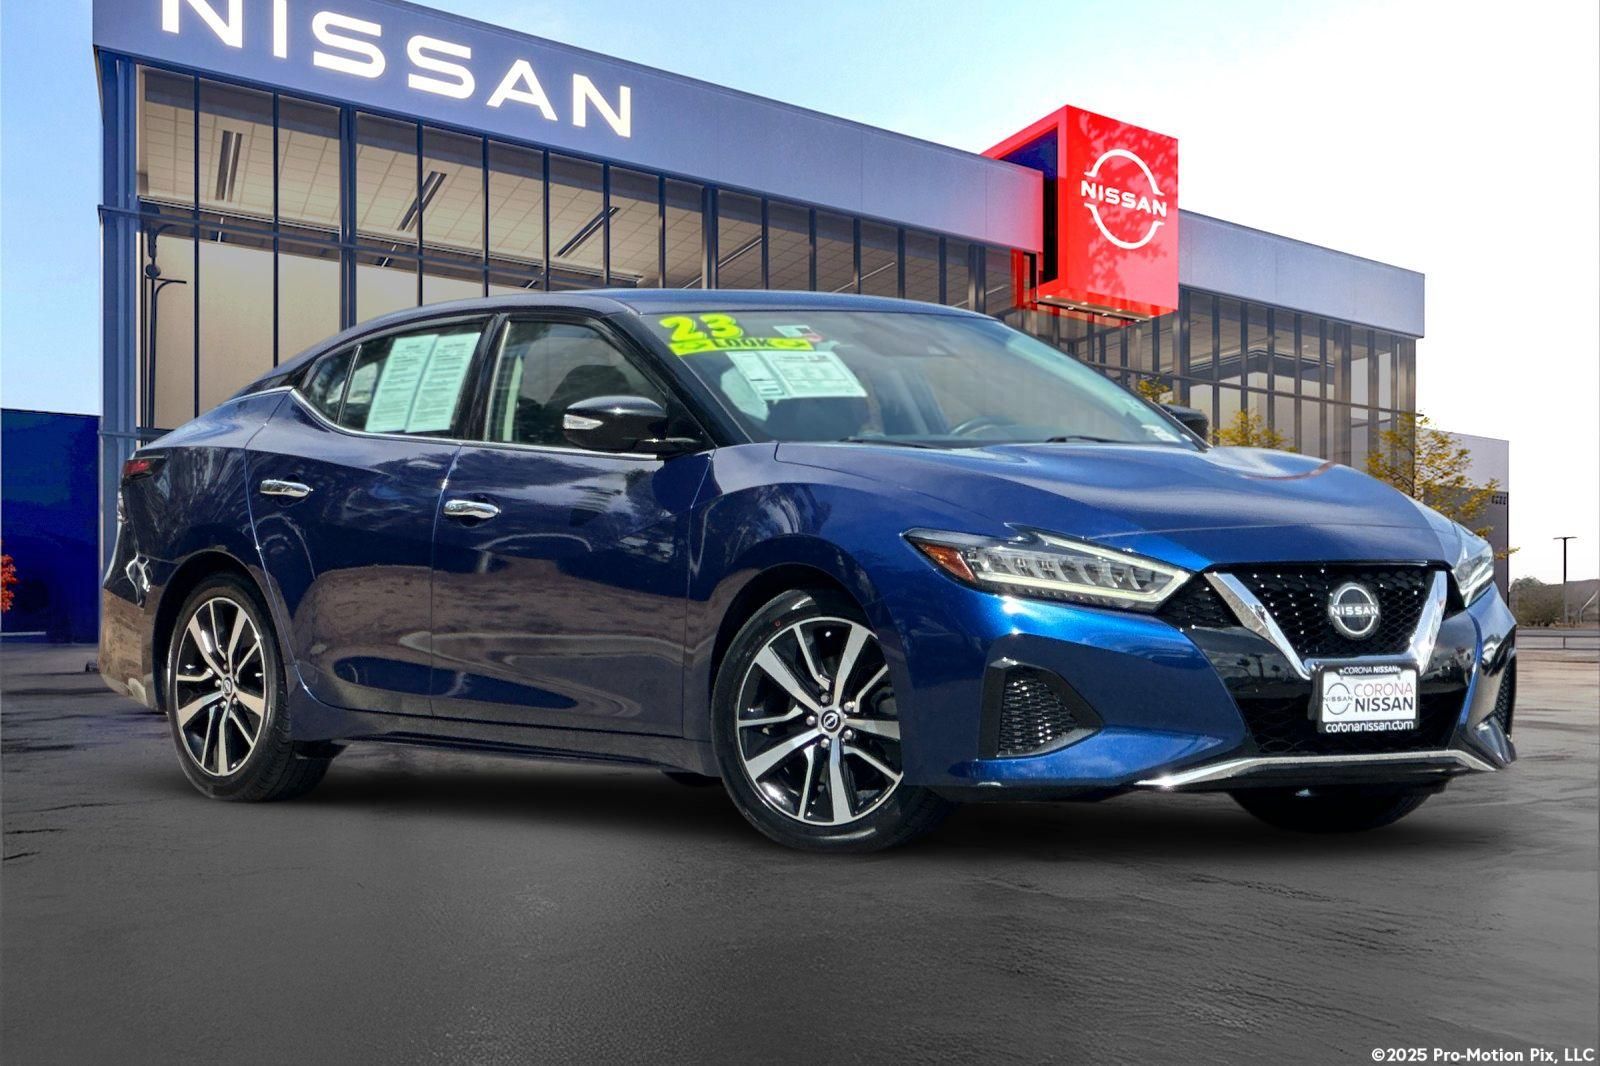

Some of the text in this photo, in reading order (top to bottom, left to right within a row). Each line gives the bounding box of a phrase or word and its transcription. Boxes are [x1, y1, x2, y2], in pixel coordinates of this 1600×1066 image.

[162, 0, 632, 138] NISSAN
[1081, 180, 1167, 217] NISSAN
[660, 312, 744, 341] 23
[1330, 606, 1379, 616] NISSAN
[1354, 683, 1413, 697] CORONA
[1355, 697, 1413, 712] NISSAN
[1326, 721, 1414, 732] coronanissan.com
